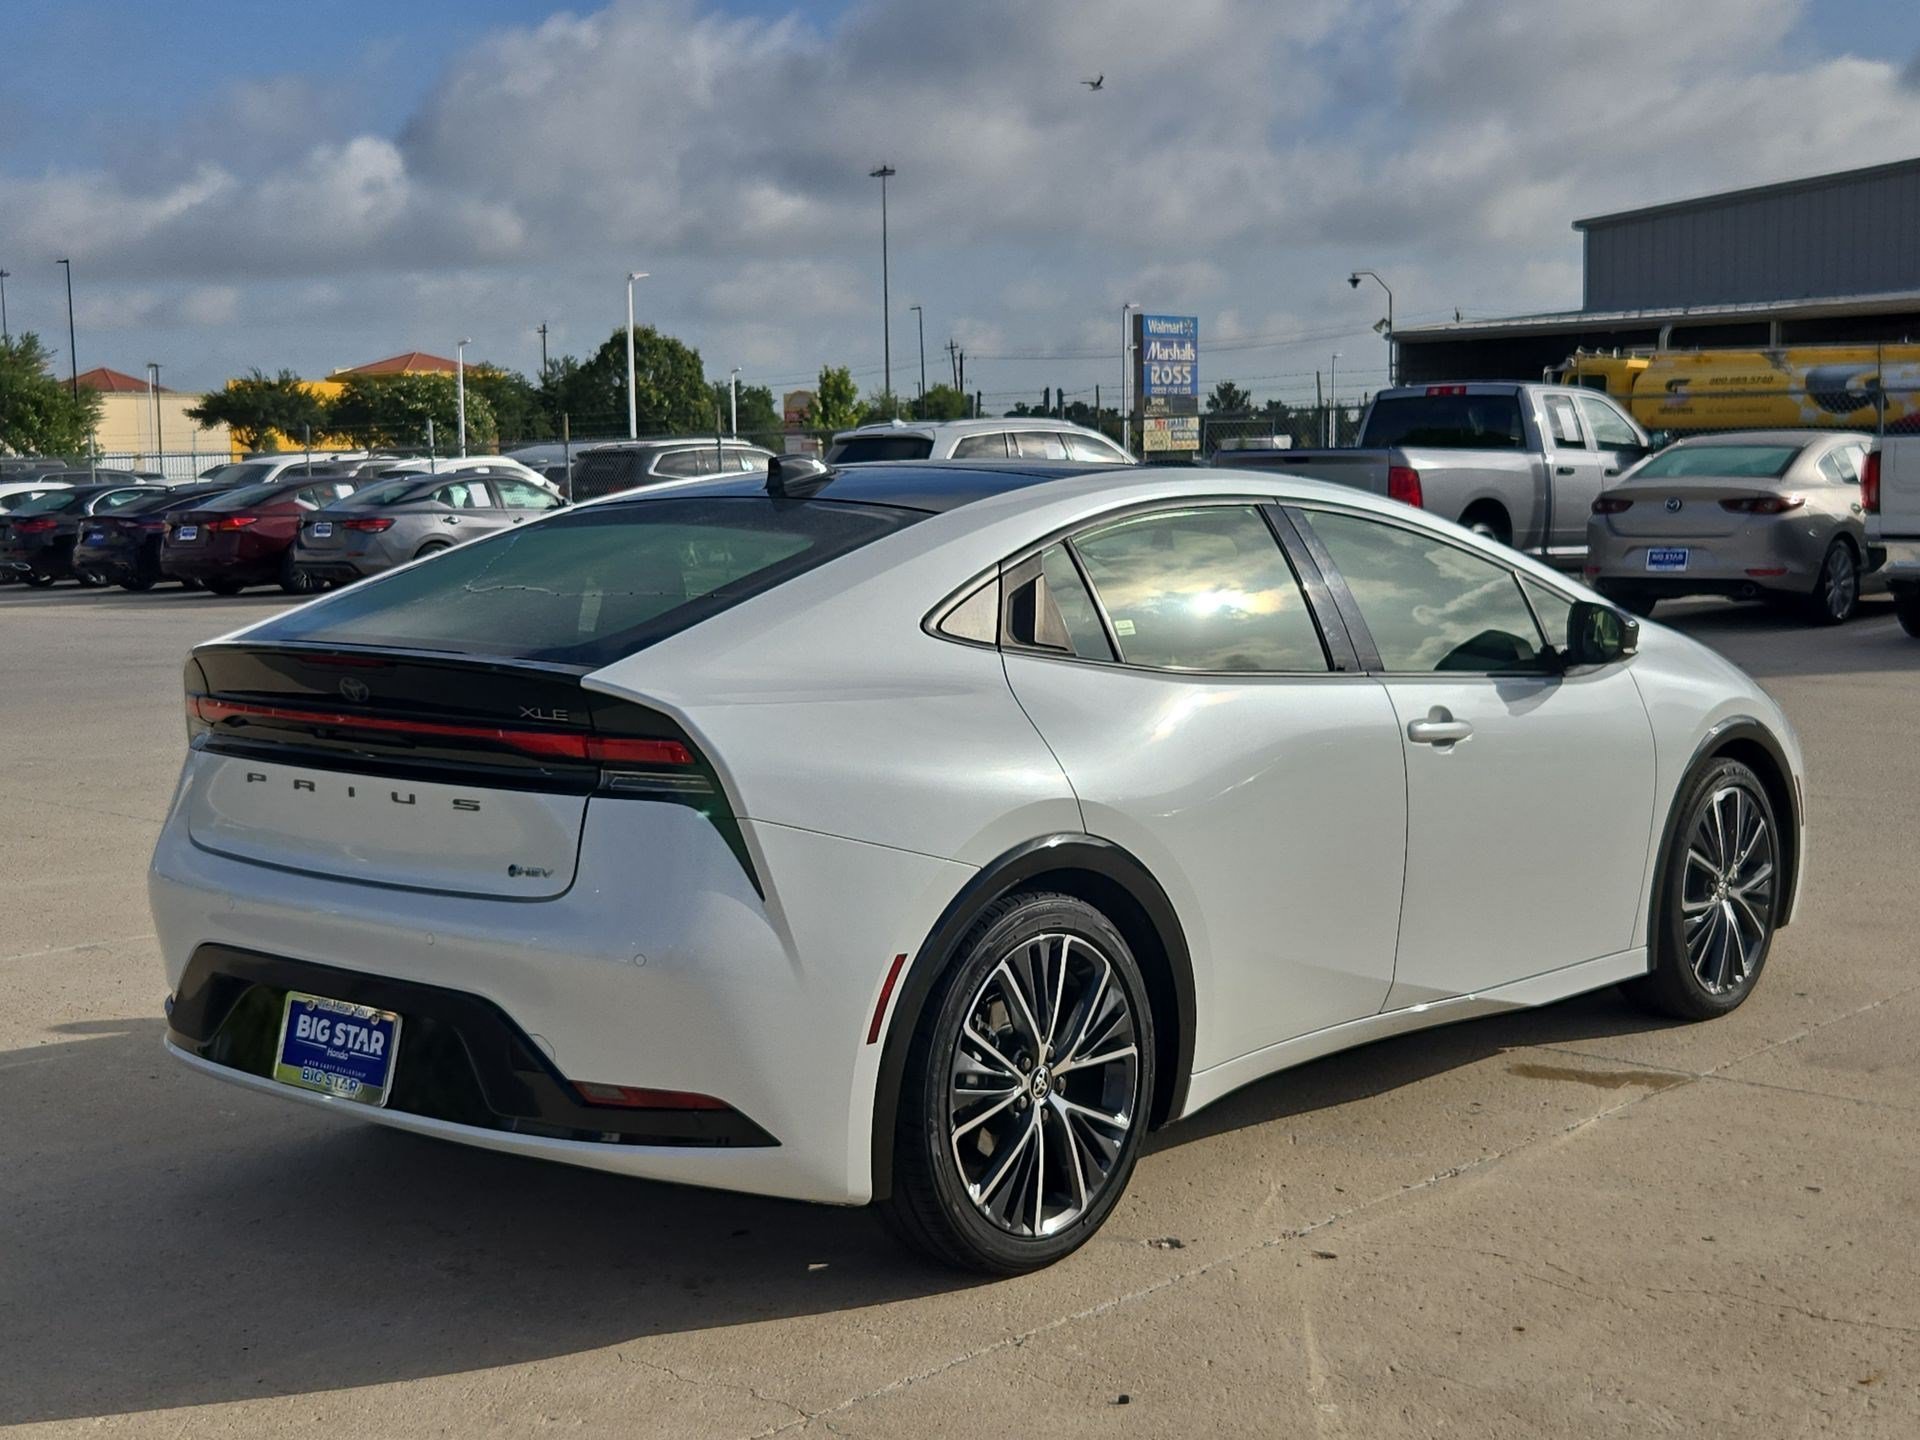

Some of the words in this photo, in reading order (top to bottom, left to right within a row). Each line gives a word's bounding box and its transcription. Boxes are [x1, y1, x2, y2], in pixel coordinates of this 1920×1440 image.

[1148, 320, 1183, 334] Walmart
[1147, 342, 1195, 361] Marshalls
[1151, 366, 1191, 385] ROSS
[519, 706, 568, 721] XLE
[246, 772, 482, 812] PRIUS
[296, 1014, 331, 1042] BIG
[333, 1022, 385, 1055] STAR
[327, 1047, 349, 1060] Honda
[302, 1068, 322, 1083] BIG
[325, 1073, 358, 1091] STAR
